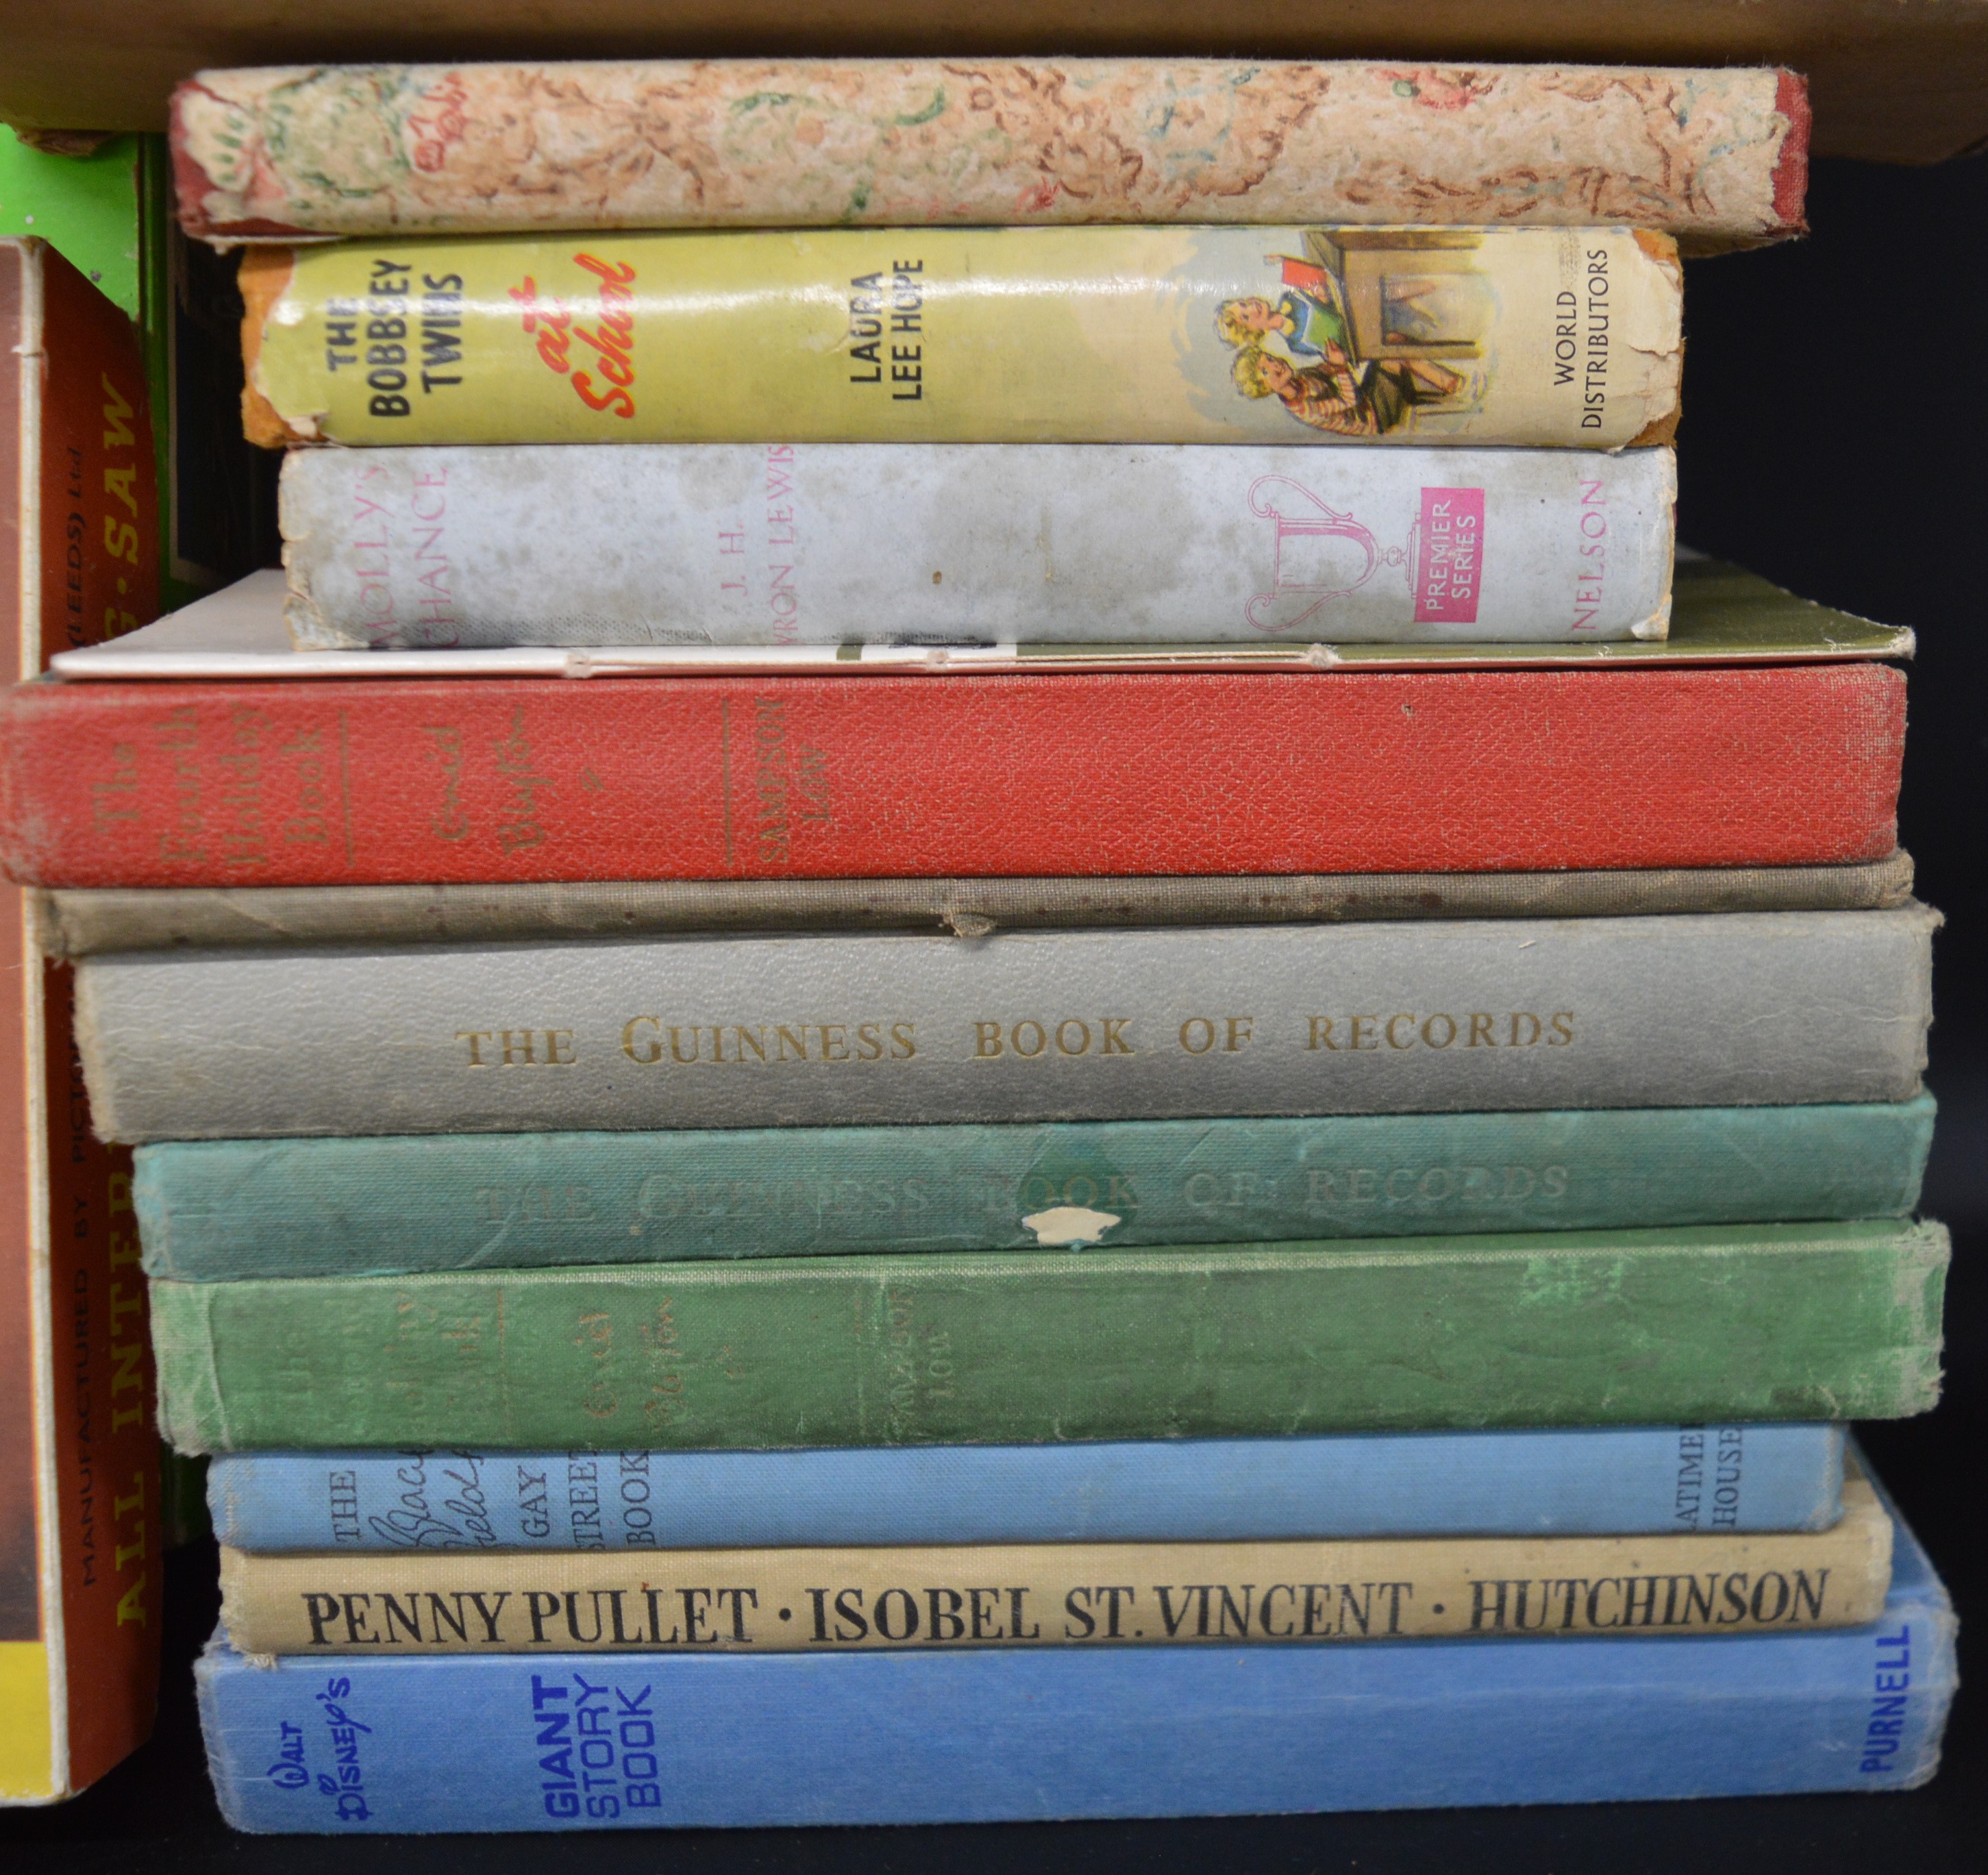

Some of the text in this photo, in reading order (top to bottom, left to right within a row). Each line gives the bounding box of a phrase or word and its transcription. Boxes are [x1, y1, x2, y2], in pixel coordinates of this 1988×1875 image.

[325, 297, 358, 372] THE
[366, 259, 412, 417] BOBBSEY
[420, 273, 463, 395] TWINS
[508, 275, 569, 373] at
[571, 252, 636, 419] School
[850, 271, 883, 382] LAURA
[891, 259, 923, 400] LEE HOPE
[1554, 291, 1576, 386] WORLD
[1581, 249, 1608, 429] DISTRIBUTORS
[767, 445, 794, 545] LEWIS
[411, 467, 460, 647] CHANCE
[719, 523, 748, 597] J. H.
[1426, 499, 1452, 610] PREMIER
[1452, 515, 1476, 599] SERIES
[1571, 478, 1607, 630] NELSON
[90, 742, 140, 834] The
[153, 706, 206, 864] Fourth
[219, 701, 273, 866] Holiday
[279, 726, 329, 843] Book
[756, 697, 788, 864] SAMPSON
[455, 1011, 1576, 1068] THE GUINNESS BOOK OF RECORDS
[74, 1195, 88, 1238] BY
[1306, 1165, 1569, 1204] RECORDS
[74, 1268, 97, 1587] MANUFACTURED
[1713, 1427, 1742, 1526] HOUSE
[114, 1471, 147, 1627] ALL
[330, 1471, 362, 1542] THE
[518, 1465, 550, 1538] GAY
[620, 1451, 656, 1545] BOOK
[301, 1591, 512, 1645] PENNY
[522, 1588, 758, 1643] PULLET
[806, 1588, 1039, 1642] ISOBEL
[1152, 1581, 1413, 1639] VINCENT
[1467, 1567, 1831, 1635] HUTCHINSON
[531, 1674, 581, 1818] GIANT
[572, 1672, 621, 1819] STORY
[616, 1684, 662, 1809] BOOK
[1860, 1624, 1911, 1773] PURNELL
